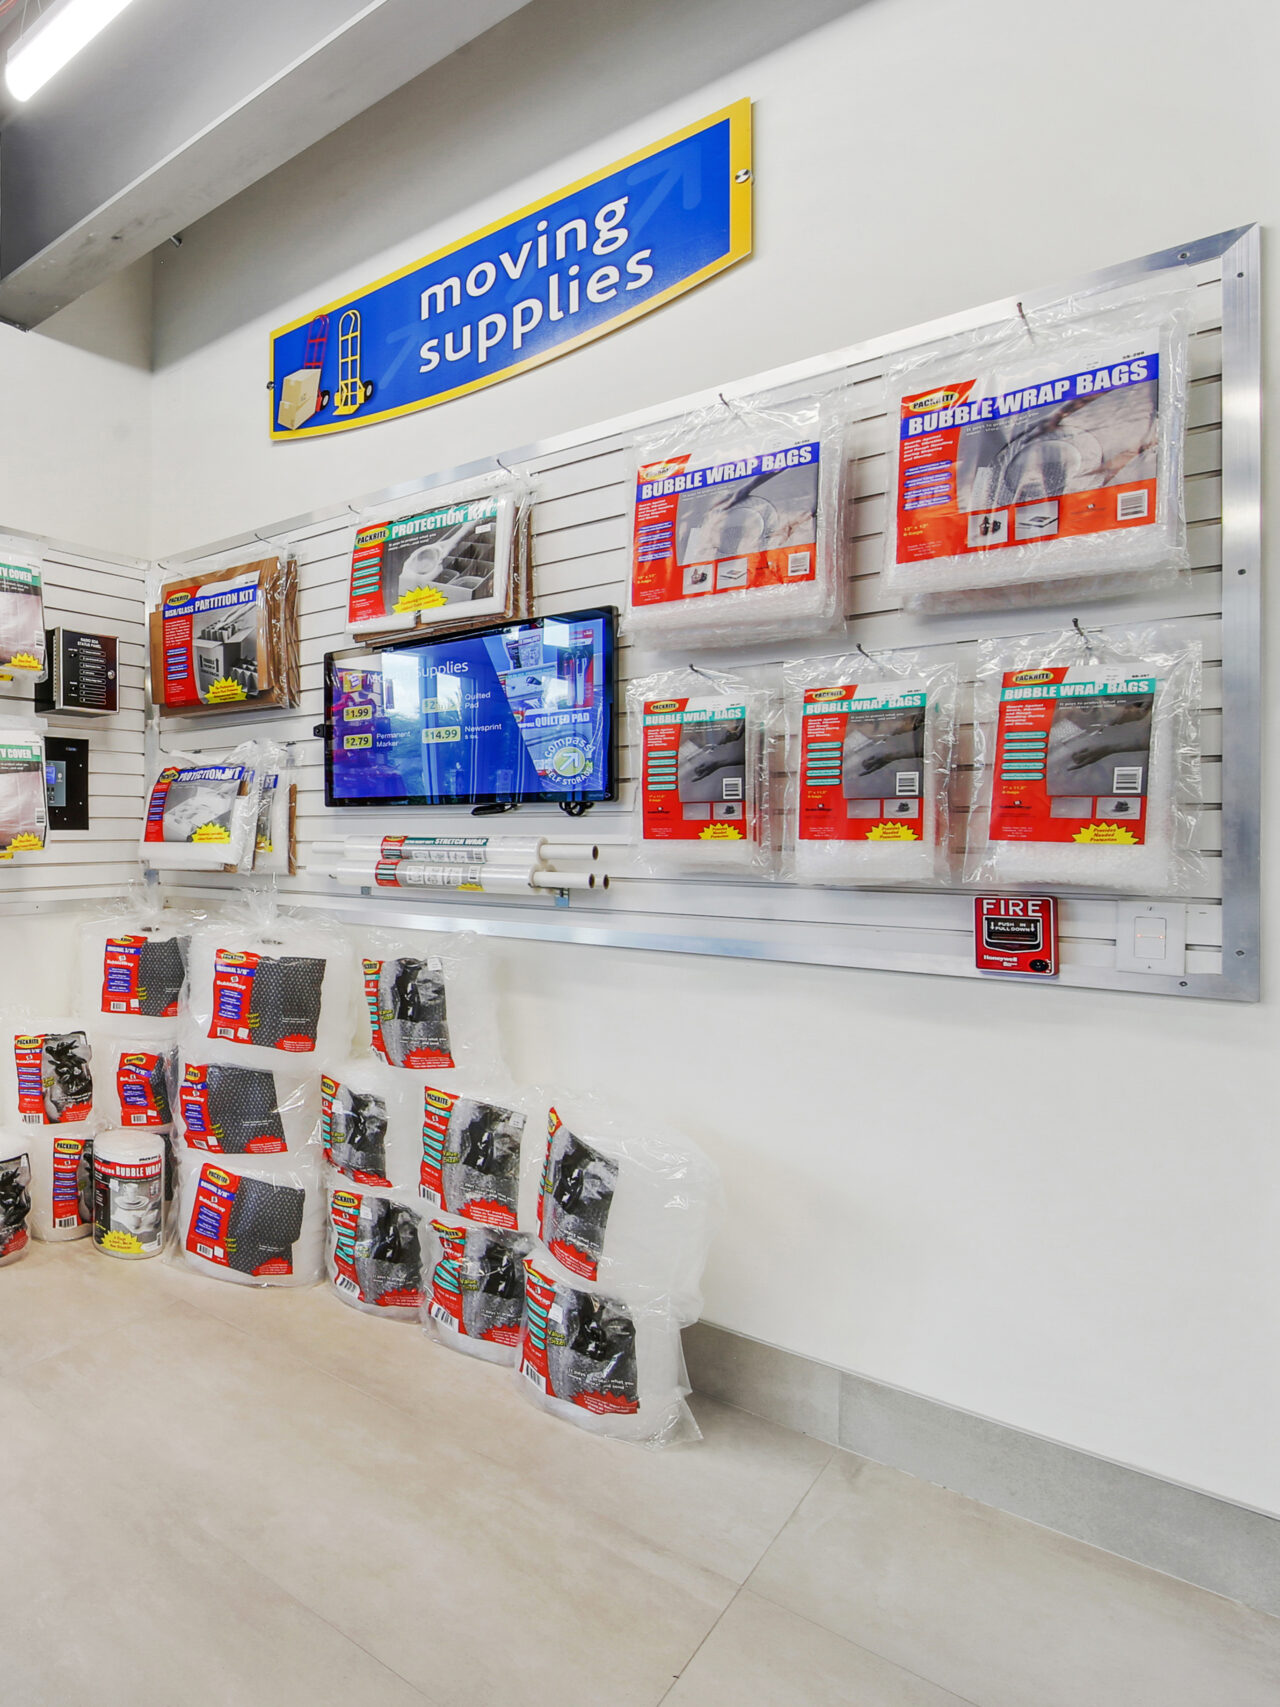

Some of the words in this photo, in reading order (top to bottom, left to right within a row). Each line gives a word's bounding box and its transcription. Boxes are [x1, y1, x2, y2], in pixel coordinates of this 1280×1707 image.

[420, 195, 629, 321] moving
[419, 248, 654, 373] supplies
[908, 401, 992, 436] BUBBLE
[996, 380, 1070, 415] WRAP
[1076, 360, 1147, 396] BAGS
[642, 471, 703, 500] BUBBLE
[707, 460, 759, 484] WRAP
[762, 446, 812, 471] BAGS
[392, 510, 465, 539] PROTECTION
[358, 529, 387, 544] PACKRITE
[9, 569, 32, 582] COVER
[195, 595, 238, 612] PARTITION
[240, 589, 254, 601] KIT
[1015, 673, 1050, 682] PACKRITE
[465, 692, 490, 700] Quilted
[1005, 687, 1057, 699] BUBBLE
[1060, 684, 1103, 697] WRAP
[1107, 681, 1149, 693] BAGS
[806, 702, 848, 714] BUBBLE
[851, 698, 886, 710] WRAP
[890, 696, 921, 707] BAGS
[346, 709, 369, 717] $1.99
[535, 714, 570, 727] QUILTED
[572, 713, 589, 722] PAD
[646, 713, 681, 725] BUBBLE
[684, 711, 712, 722] WRAP
[714, 708, 741, 720] BAGS
[425, 730, 457, 740] $14.99
[465, 724, 502, 732] Newsprint
[346, 737, 369, 745] $2.79
[8, 749, 32, 759] COVER
[983, 899, 1042, 916] FIRE
[116, 1165, 144, 1176] BUBBLE
